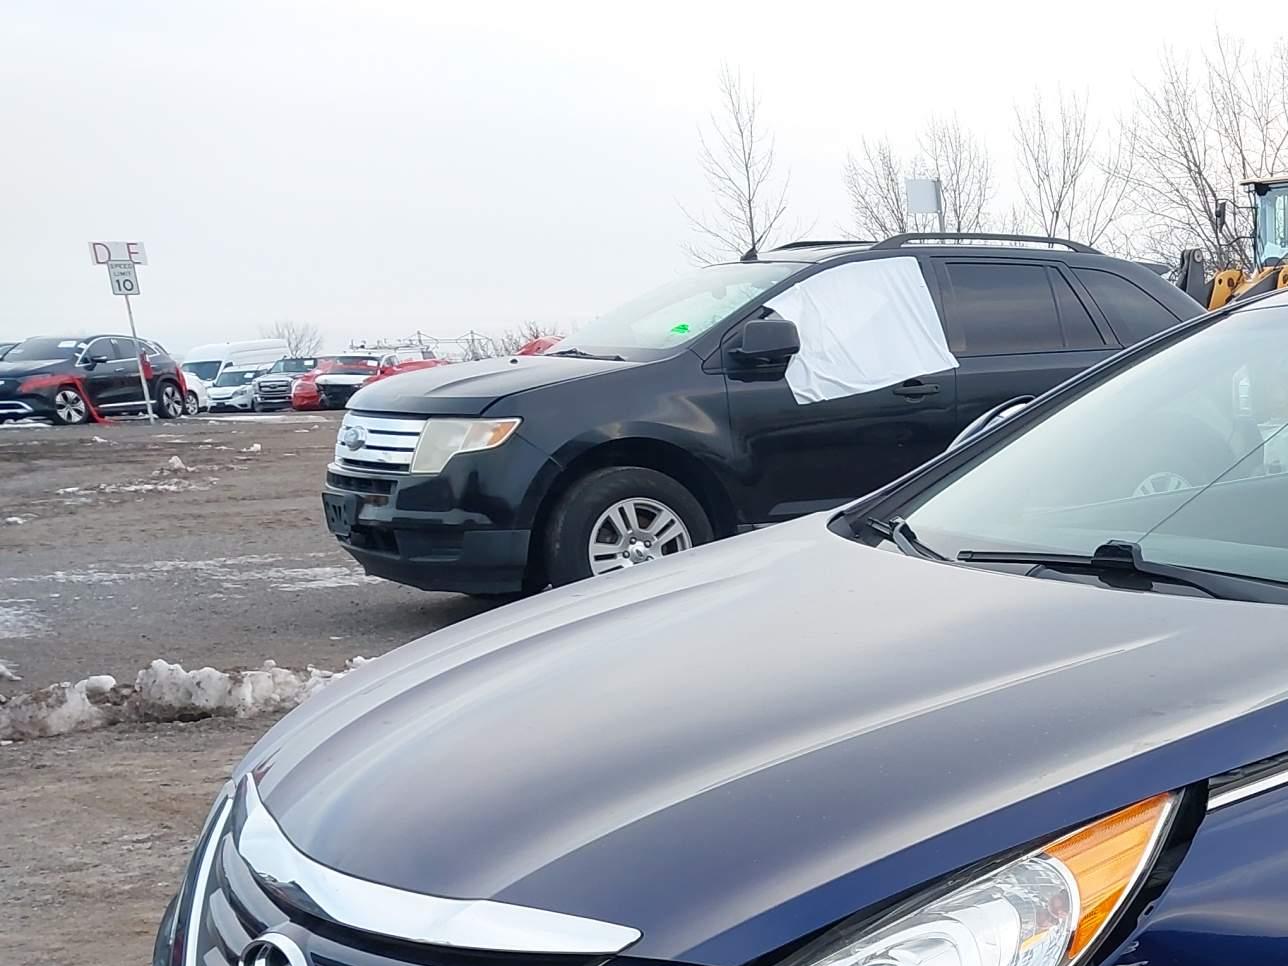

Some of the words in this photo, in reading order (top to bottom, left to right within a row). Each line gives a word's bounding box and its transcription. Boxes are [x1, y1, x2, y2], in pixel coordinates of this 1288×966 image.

[92, 242, 111, 264] D
[126, 242, 142, 264] E
[116, 279, 134, 292] 10
